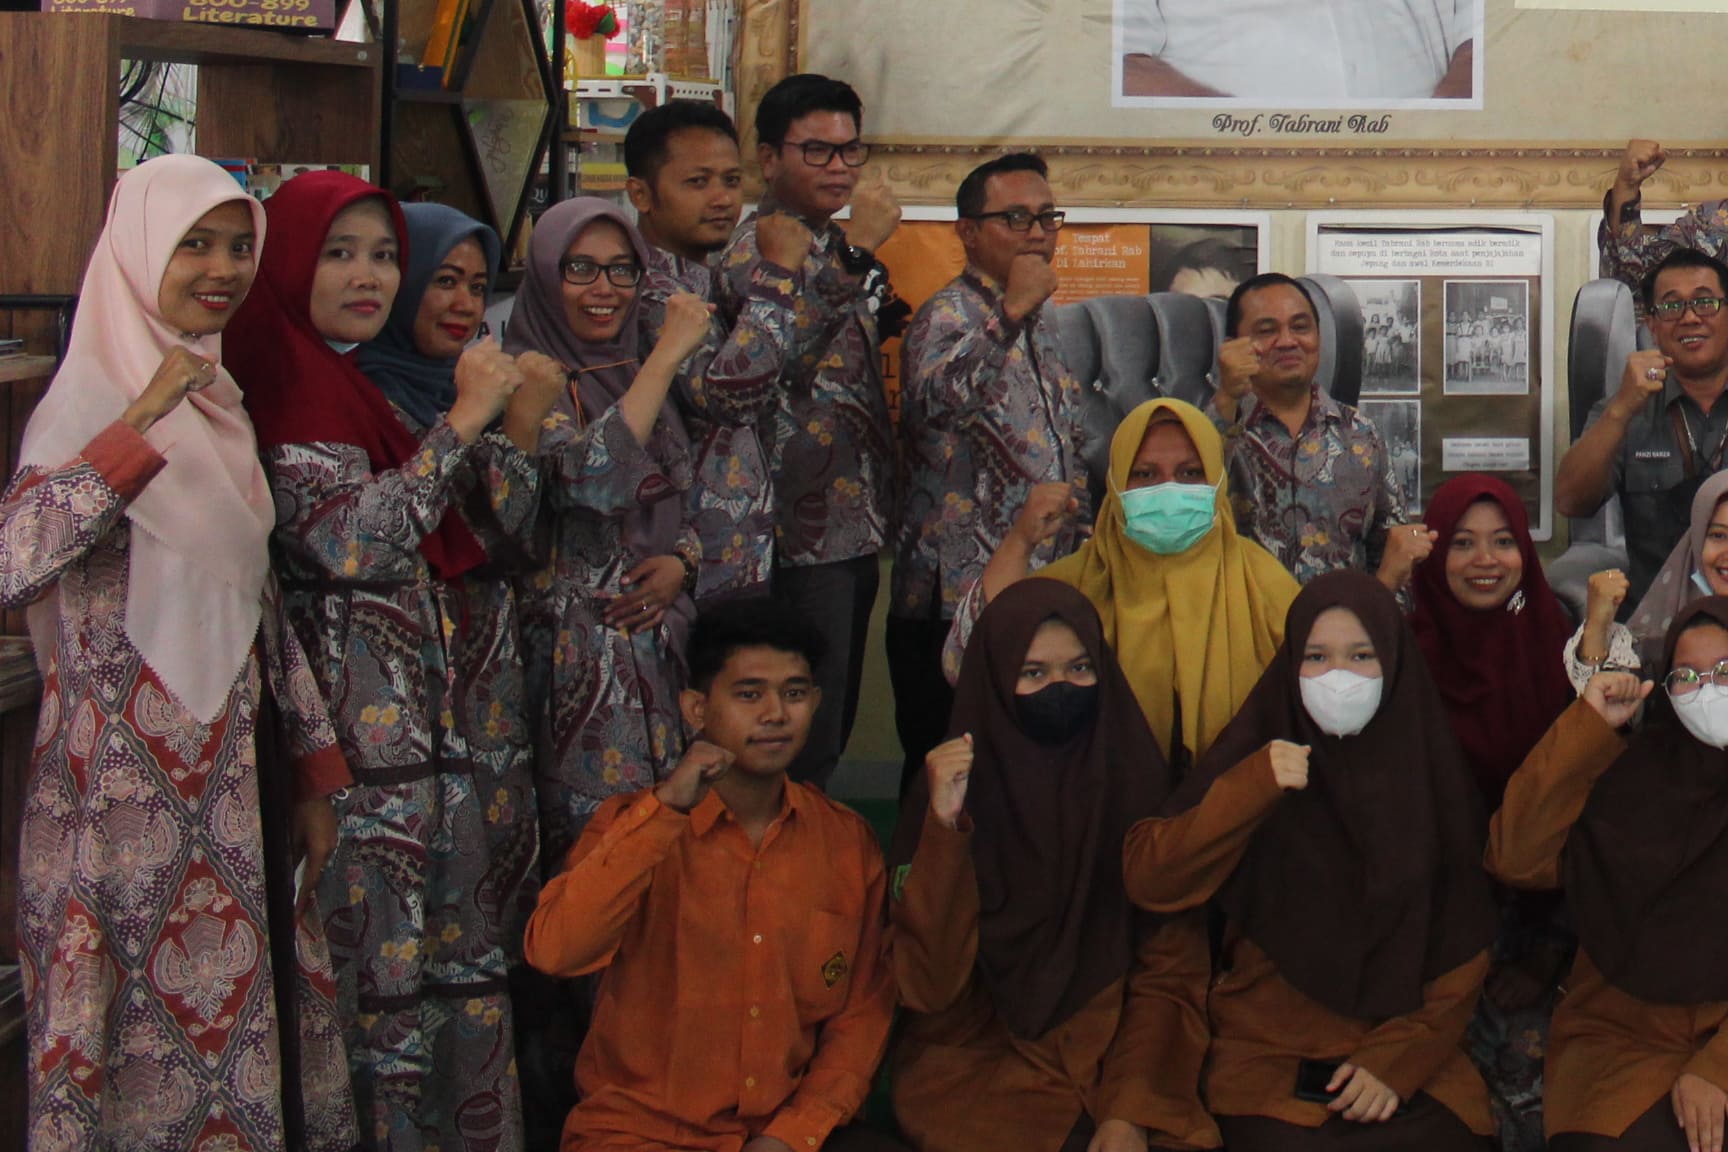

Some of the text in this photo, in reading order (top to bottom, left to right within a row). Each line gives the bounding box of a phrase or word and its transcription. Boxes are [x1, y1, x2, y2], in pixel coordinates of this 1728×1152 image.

[182, 7, 318, 27] Literature
[1212, 113, 1392, 136] Prof. Tabrani Rab
